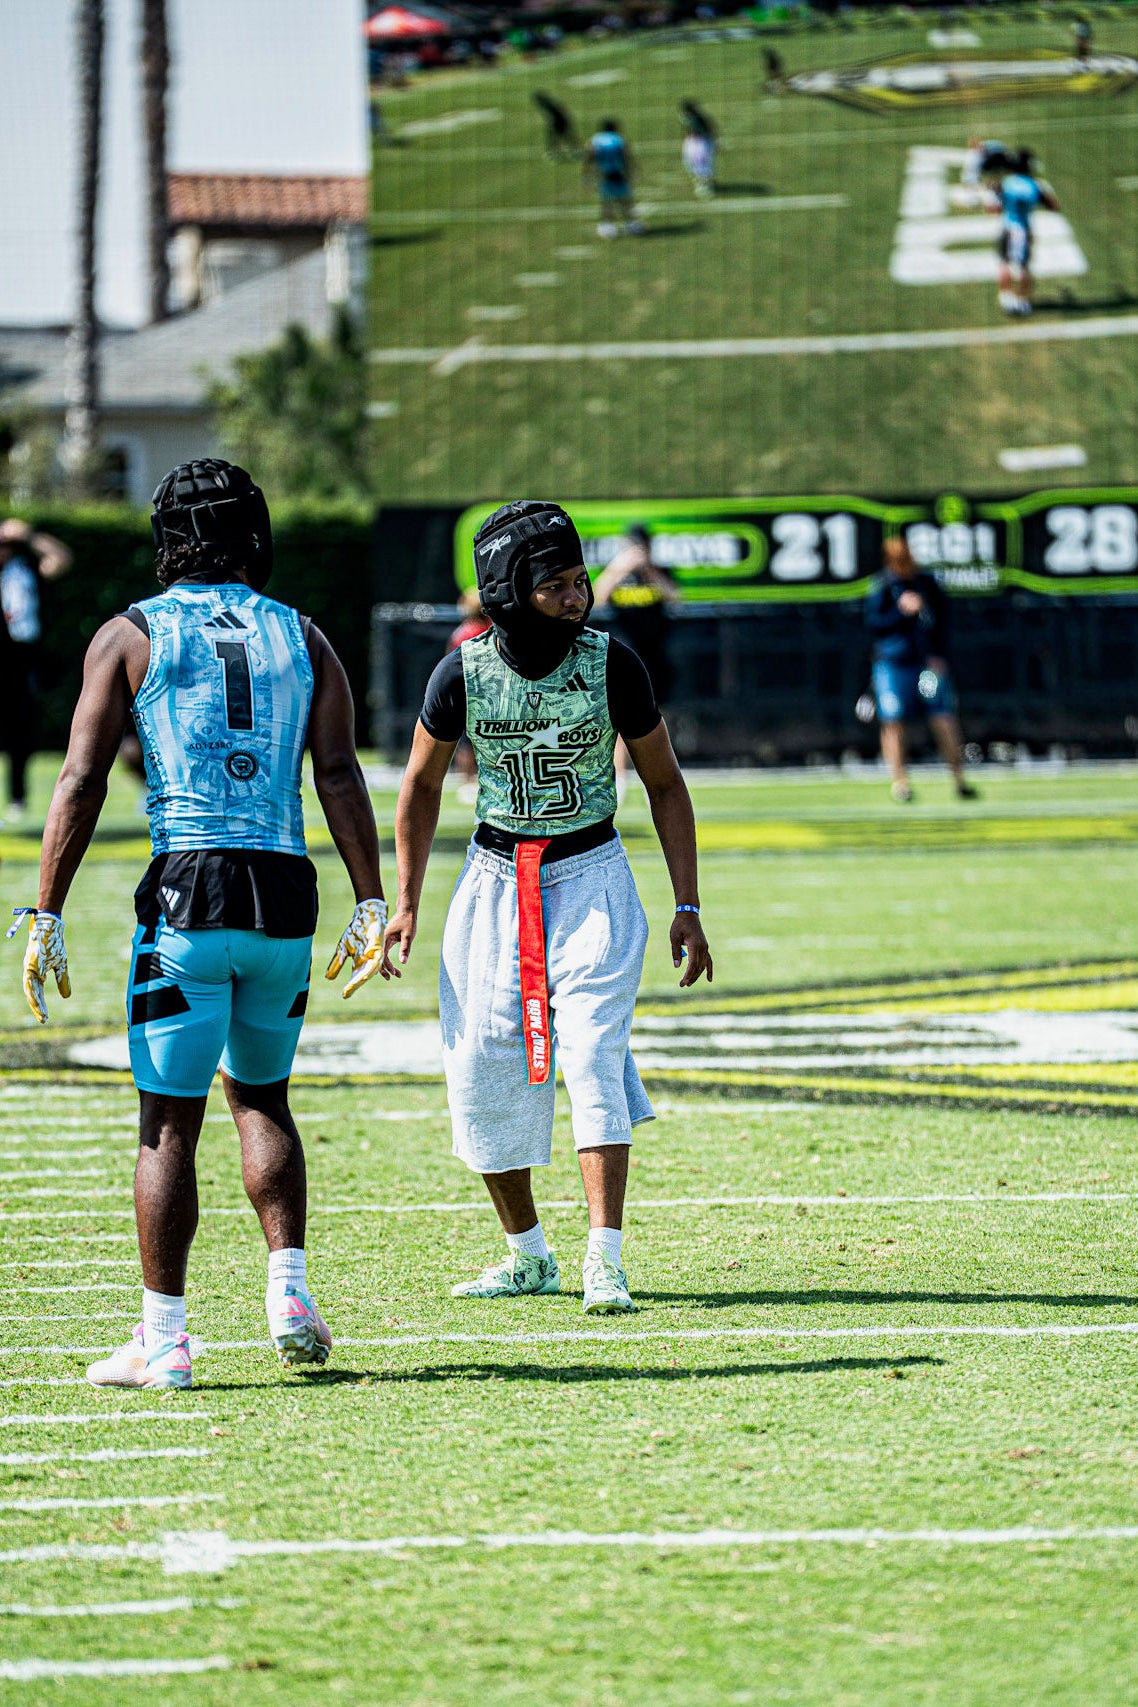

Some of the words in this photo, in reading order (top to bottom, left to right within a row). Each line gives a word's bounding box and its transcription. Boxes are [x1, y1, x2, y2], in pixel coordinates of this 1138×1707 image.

[770, 512, 858, 580] 21
[1044, 505, 1137, 574] 28
[214, 640, 254, 731] 1
[483, 720, 551, 734] TRILLION
[496, 748, 583, 821] 15
[532, 1030, 545, 1069] STRAP
